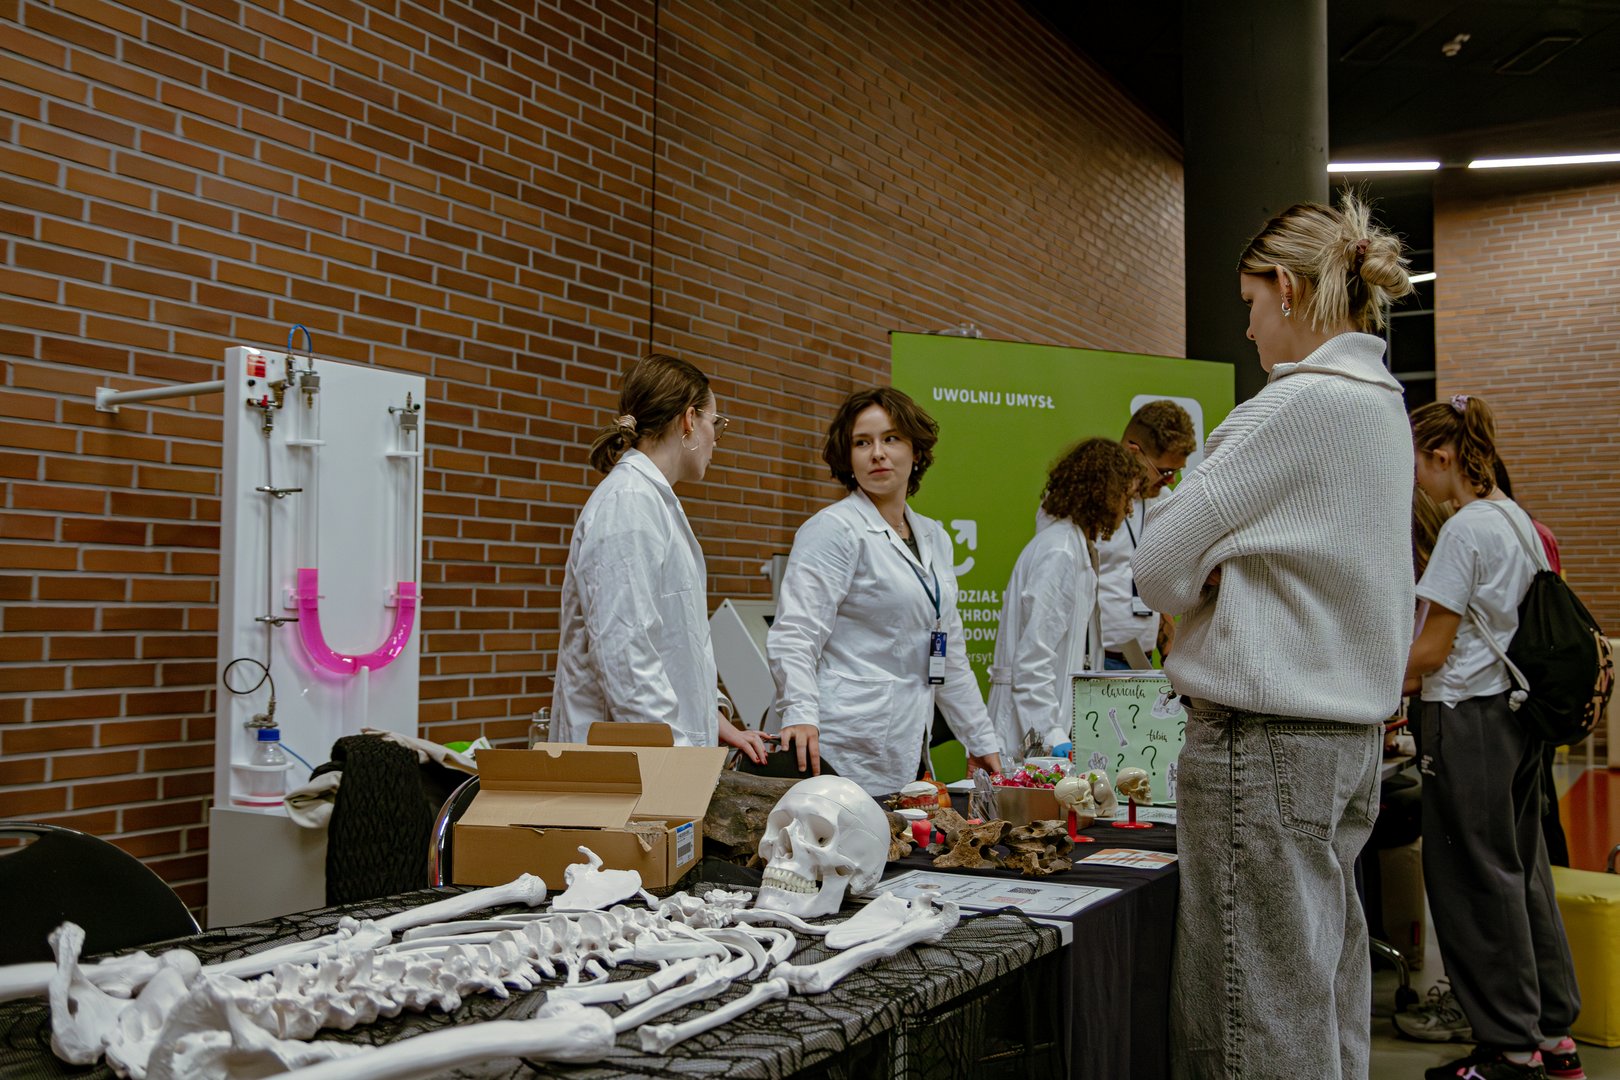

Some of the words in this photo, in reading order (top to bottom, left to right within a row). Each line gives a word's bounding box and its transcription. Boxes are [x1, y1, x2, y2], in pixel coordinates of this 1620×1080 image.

[933, 387, 1001, 405] UWOLNIJ
[1005, 393, 1055, 409] UMYSŁ
[958, 590, 999, 603] DZIAŁ
[963, 628, 997, 641] DOW
